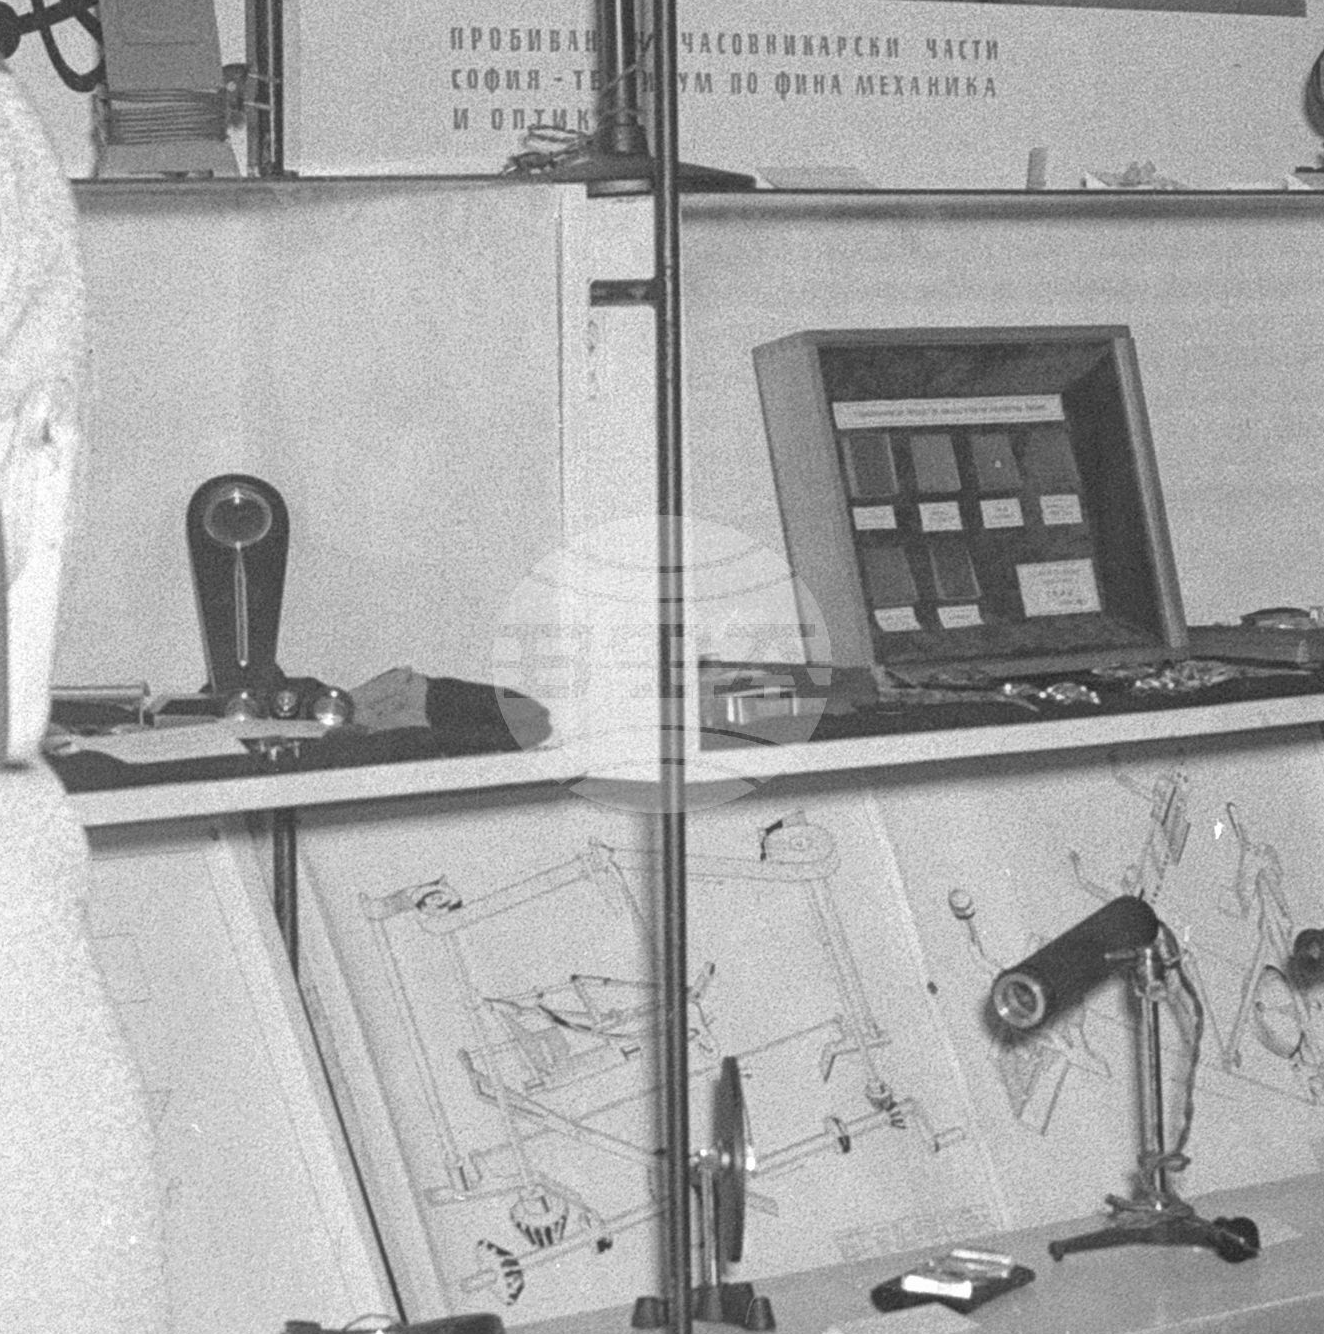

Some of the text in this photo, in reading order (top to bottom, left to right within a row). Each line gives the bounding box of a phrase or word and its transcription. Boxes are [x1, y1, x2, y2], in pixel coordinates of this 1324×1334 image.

[681, 31, 900, 60] ЧАСОВНИКАРСКИ
[926, 38, 1000, 61] ЧАСТИ
[730, 72, 758, 95] ПО
[775, 71, 843, 100] ФИНА
[855, 75, 998, 99] МЕХАНИКА
[453, 107, 469, 130] И
